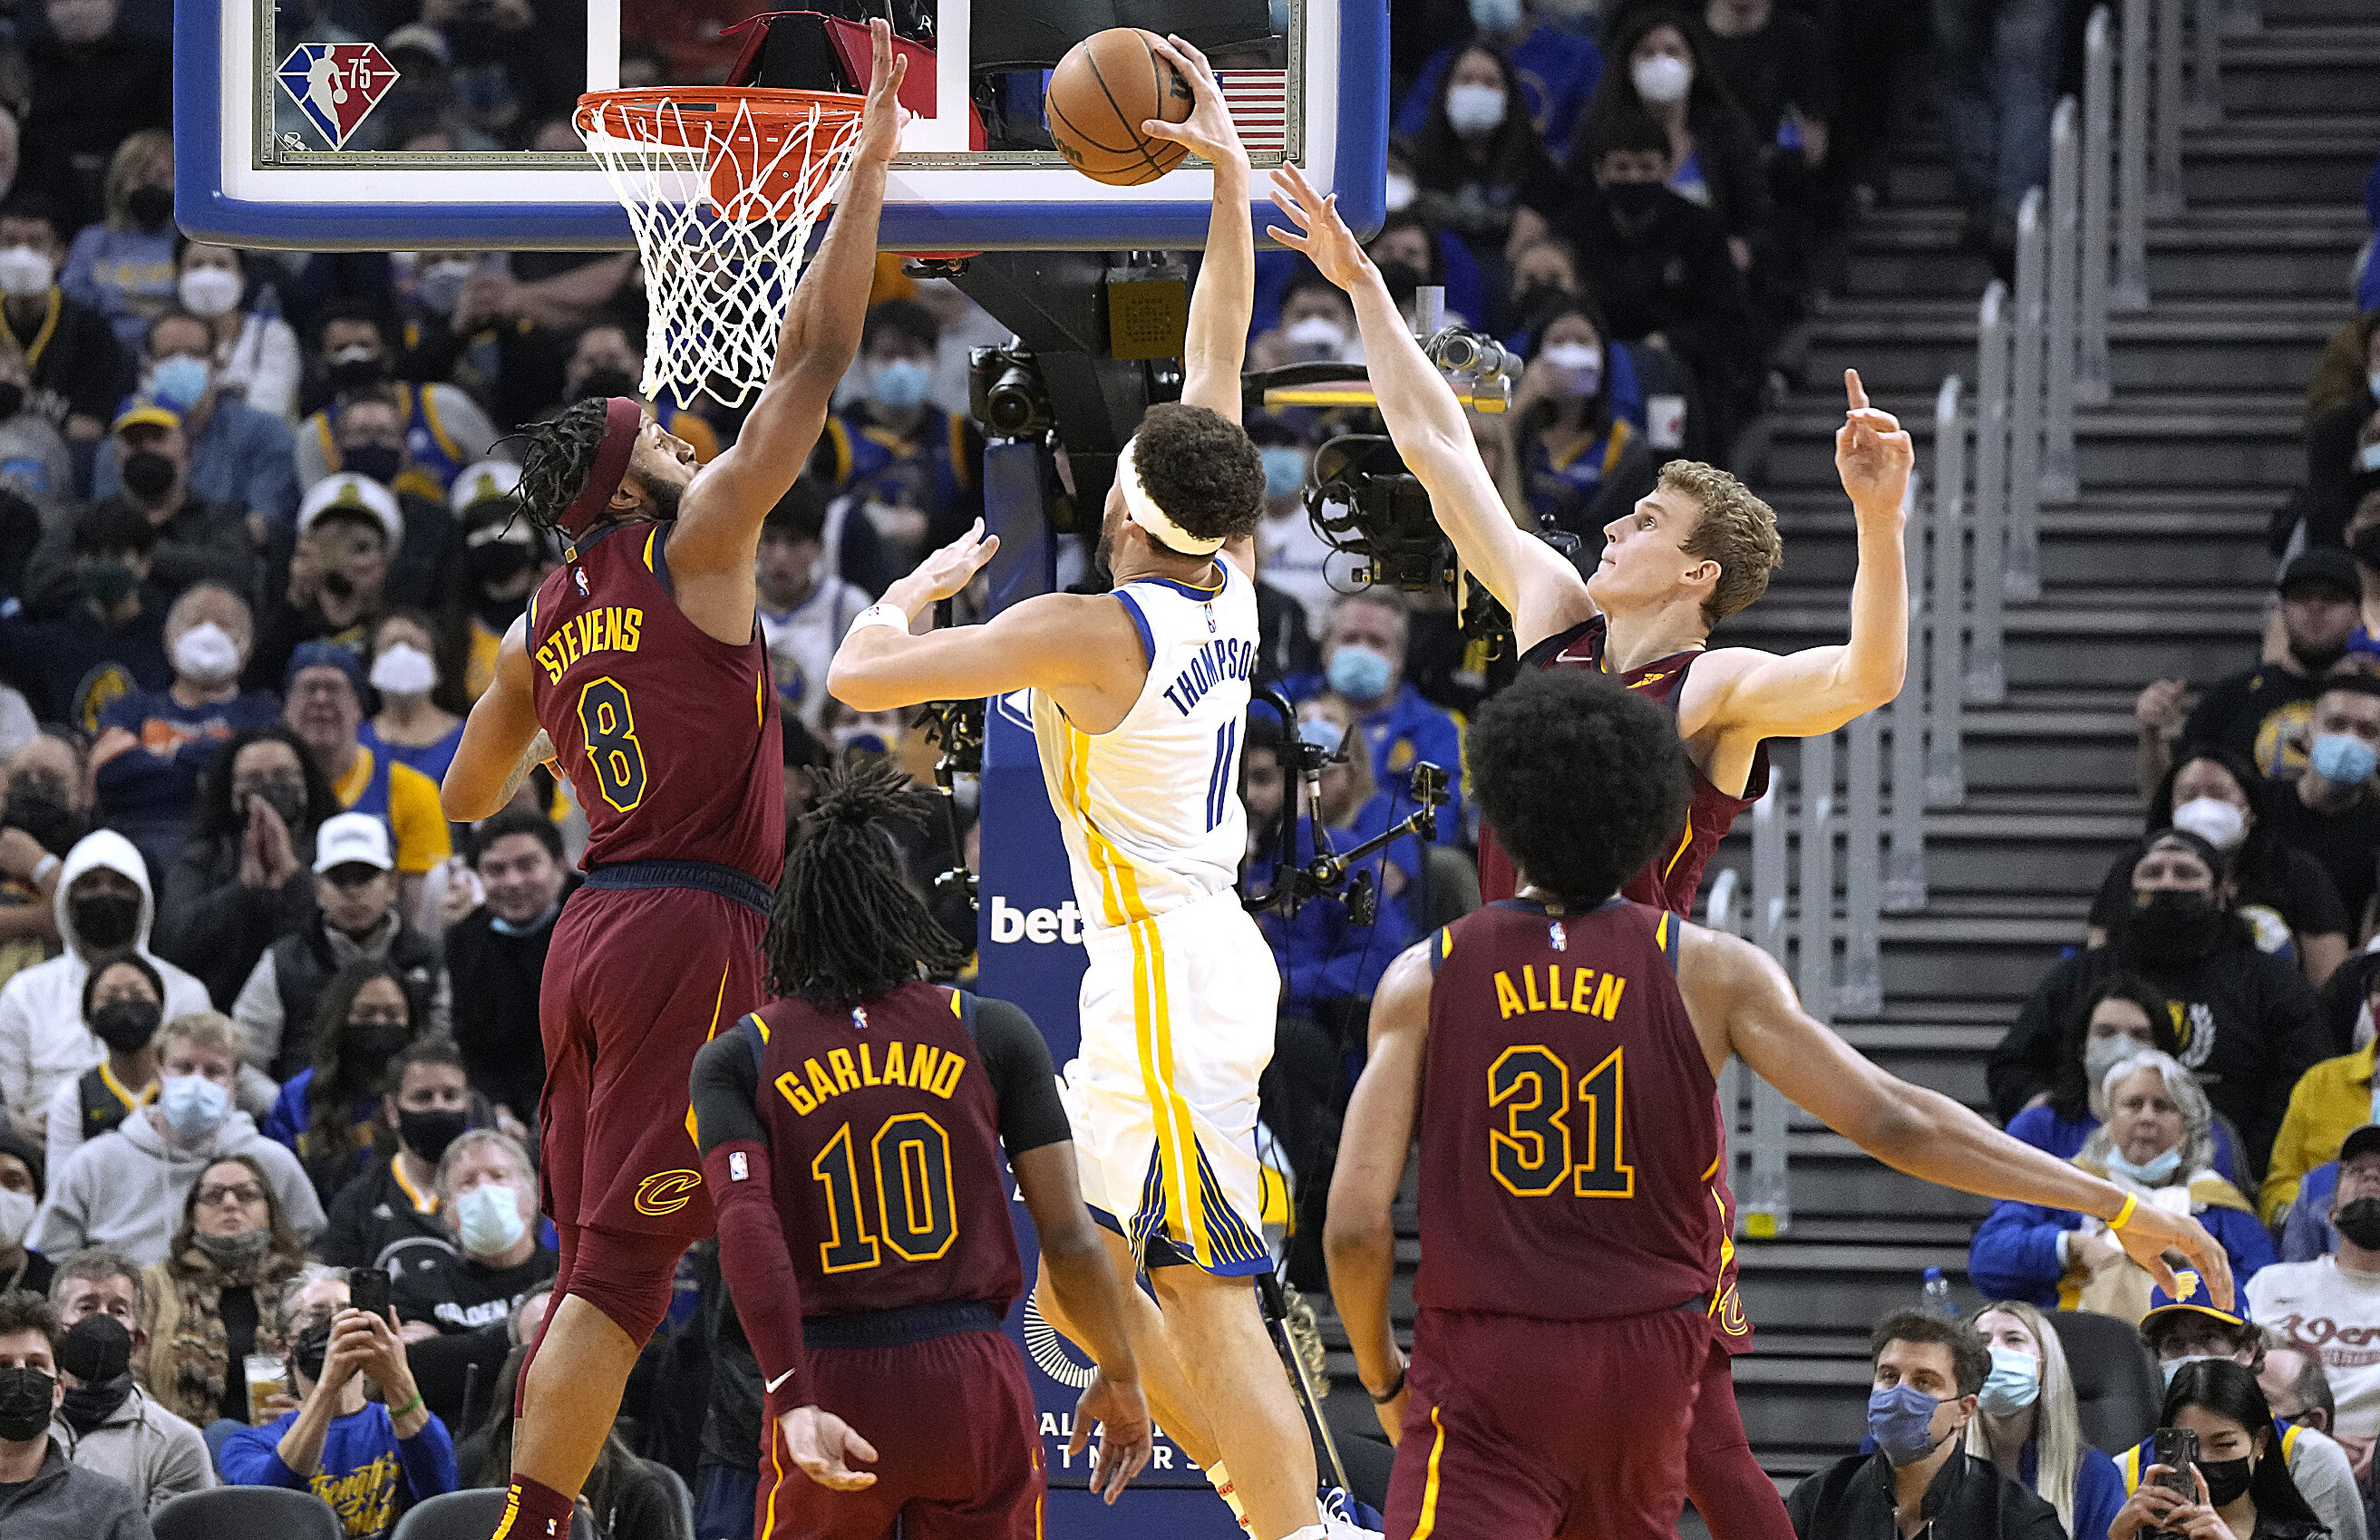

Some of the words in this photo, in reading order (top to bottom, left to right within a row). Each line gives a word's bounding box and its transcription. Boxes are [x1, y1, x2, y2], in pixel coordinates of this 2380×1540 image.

[347, 58, 371, 89] 75
[535, 606, 643, 686] STEVENS
[1162, 637, 1256, 717] THOMPSO
[577, 675, 647, 813] 8
[1206, 715, 1237, 834] 11
[1493, 964, 1627, 1022] ALLEN
[773, 1041, 967, 1117] GARLAND
[1487, 1043, 1636, 1199] 31
[811, 1111, 959, 1275] 10
